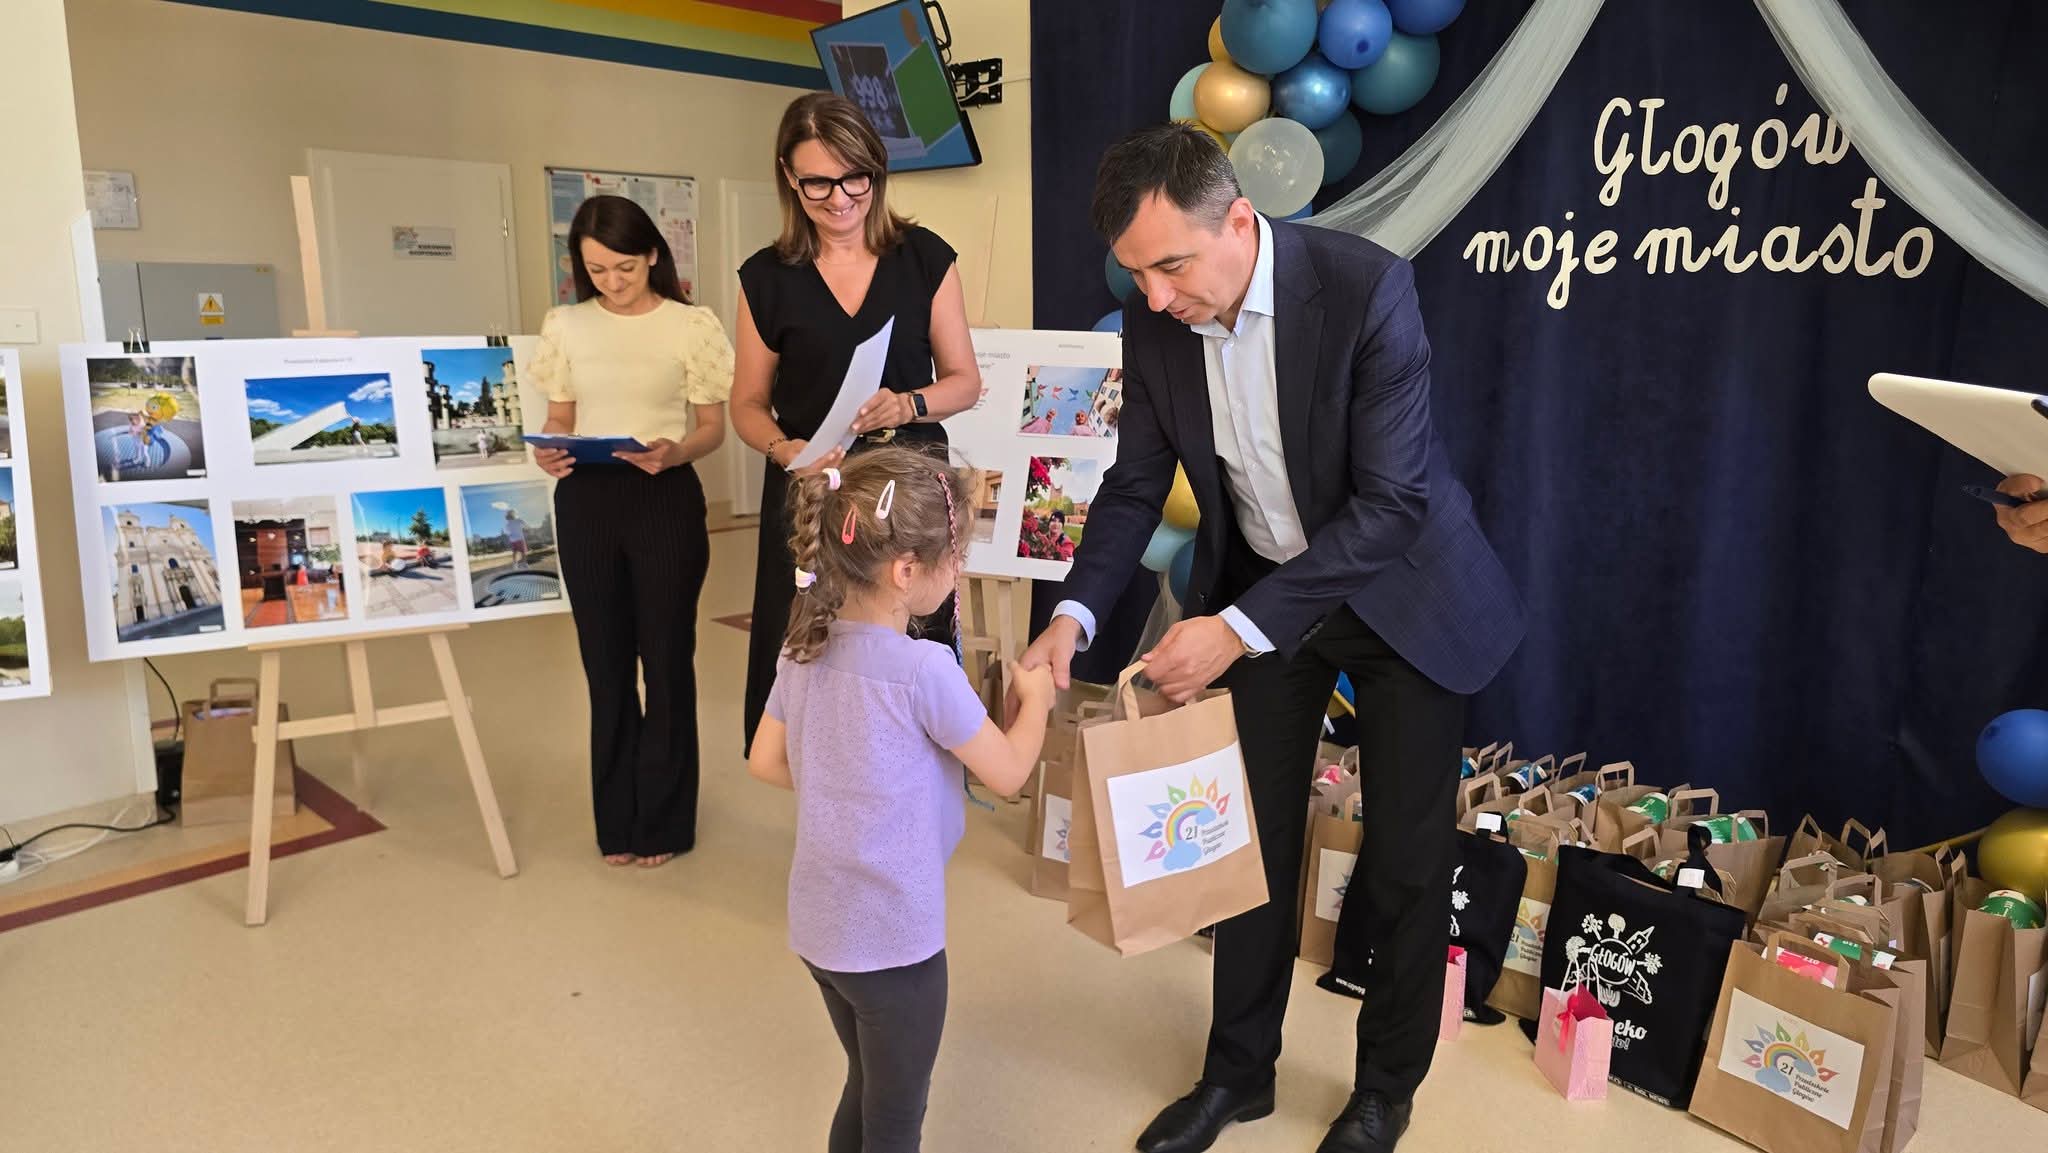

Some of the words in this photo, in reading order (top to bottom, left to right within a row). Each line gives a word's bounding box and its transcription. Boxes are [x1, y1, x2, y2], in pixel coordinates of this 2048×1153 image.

[1594, 83, 1852, 210] Głogów
[1463, 211, 1619, 309] moje
[1633, 177, 1934, 279] miasto
[1185, 826, 1198, 840] 21
[1590, 943, 1636, 977] GŁOGÓW
[1614, 1019, 1648, 1040] eko
[1780, 1062, 1794, 1076] 21
